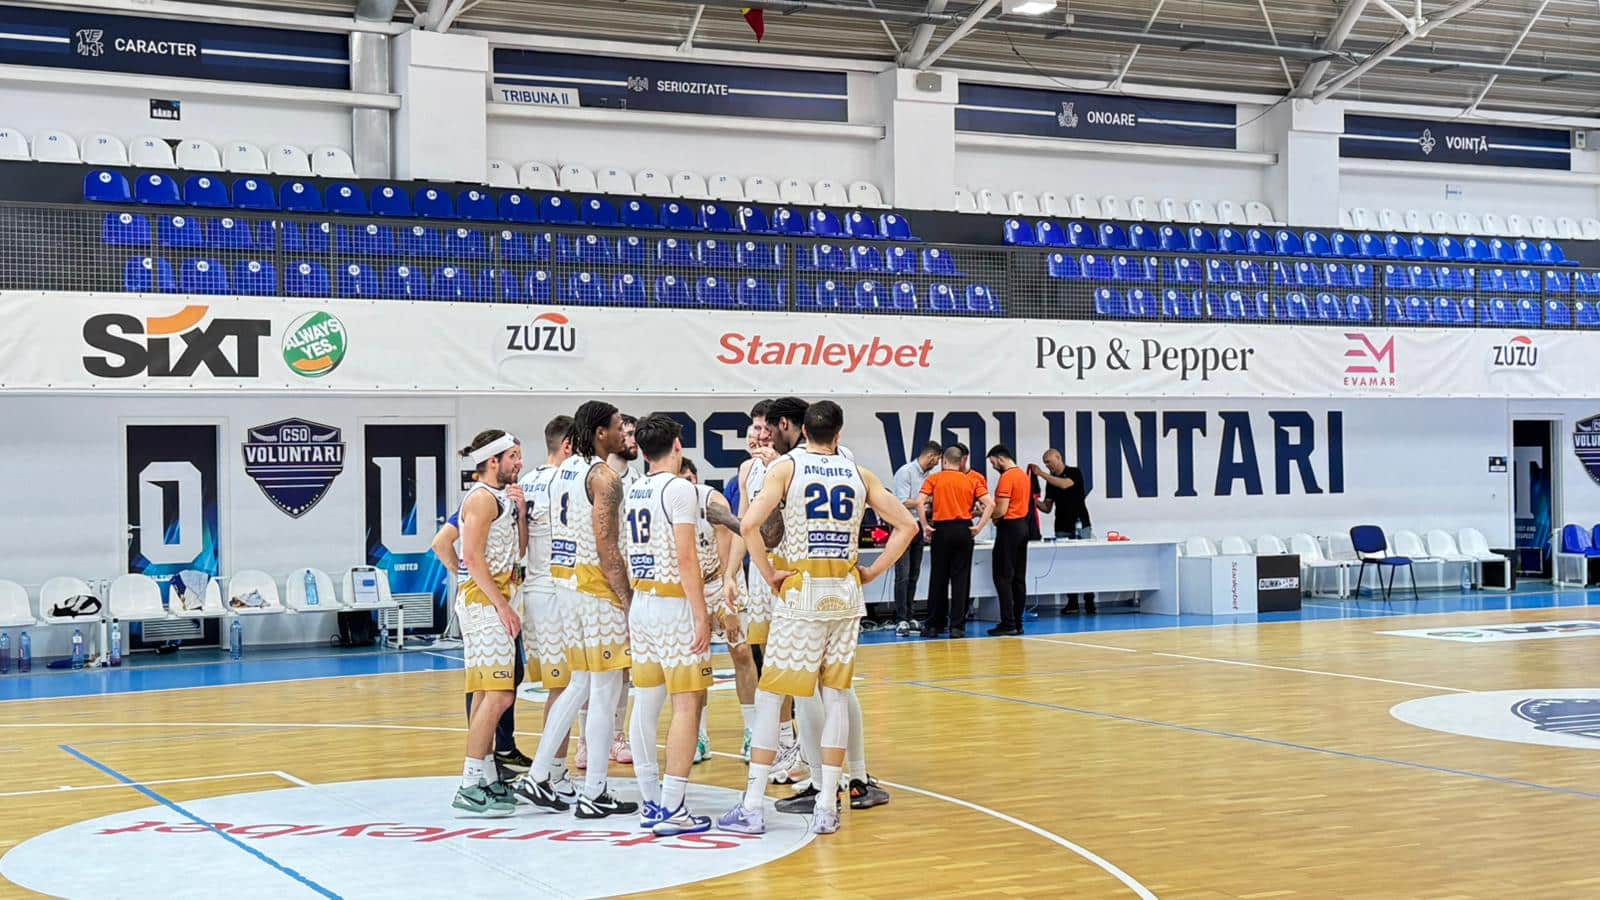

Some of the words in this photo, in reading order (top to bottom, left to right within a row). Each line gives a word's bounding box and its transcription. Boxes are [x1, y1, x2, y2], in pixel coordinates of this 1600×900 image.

[115, 38, 197, 57] CARACTER
[502, 89, 559, 105] TRIBUNA
[562, 94, 569, 105] II
[656, 80, 728, 96] SERIOZITATE
[1087, 111, 1135, 126] ONOARE
[1446, 136, 1488, 154] VOINȚĂ
[283, 318, 340, 350] ALWAYS
[506, 324, 576, 352] ZUZU
[301, 341, 337, 360] YES.
[716, 331, 934, 374] Stanleybet
[1035, 336, 1097, 380] Pep
[1106, 337, 1132, 371] &
[1141, 338, 1256, 381] Pepper
[1493, 345, 1538, 367] ZUZU
[1343, 377, 1396, 387] EVAMAR
[282, 428, 308, 442] CSO
[246, 446, 341, 463] VOLUNTARI
[804, 482, 856, 521] 26
[627, 508, 652, 544] 13
